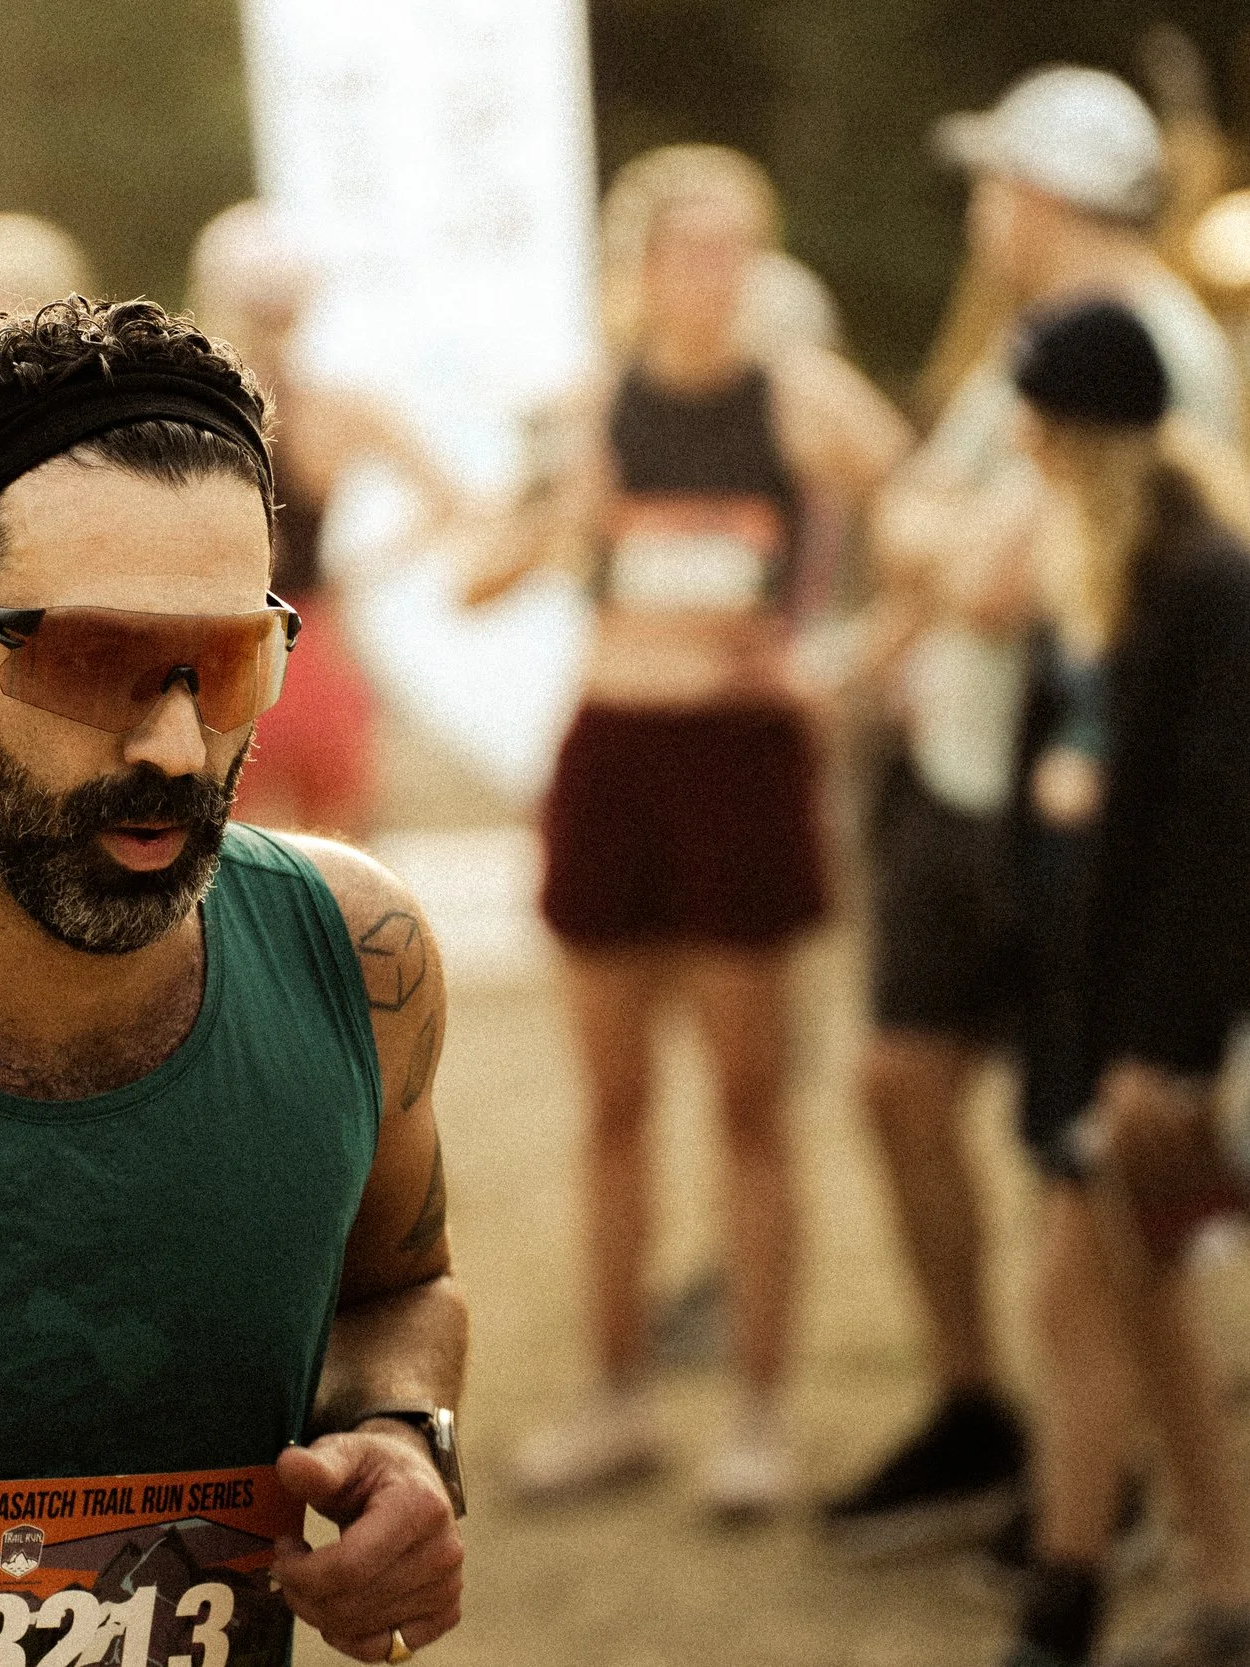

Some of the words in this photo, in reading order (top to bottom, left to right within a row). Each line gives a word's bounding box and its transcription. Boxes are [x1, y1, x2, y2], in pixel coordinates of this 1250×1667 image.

[81, 1487, 135, 1517] TRAIL
[141, 1484, 184, 1514] RUN
[187, 1479, 255, 1512] SERIES
[4, 1532, 24, 1544] TRAIL
[25, 1532, 43, 1543] RUN
